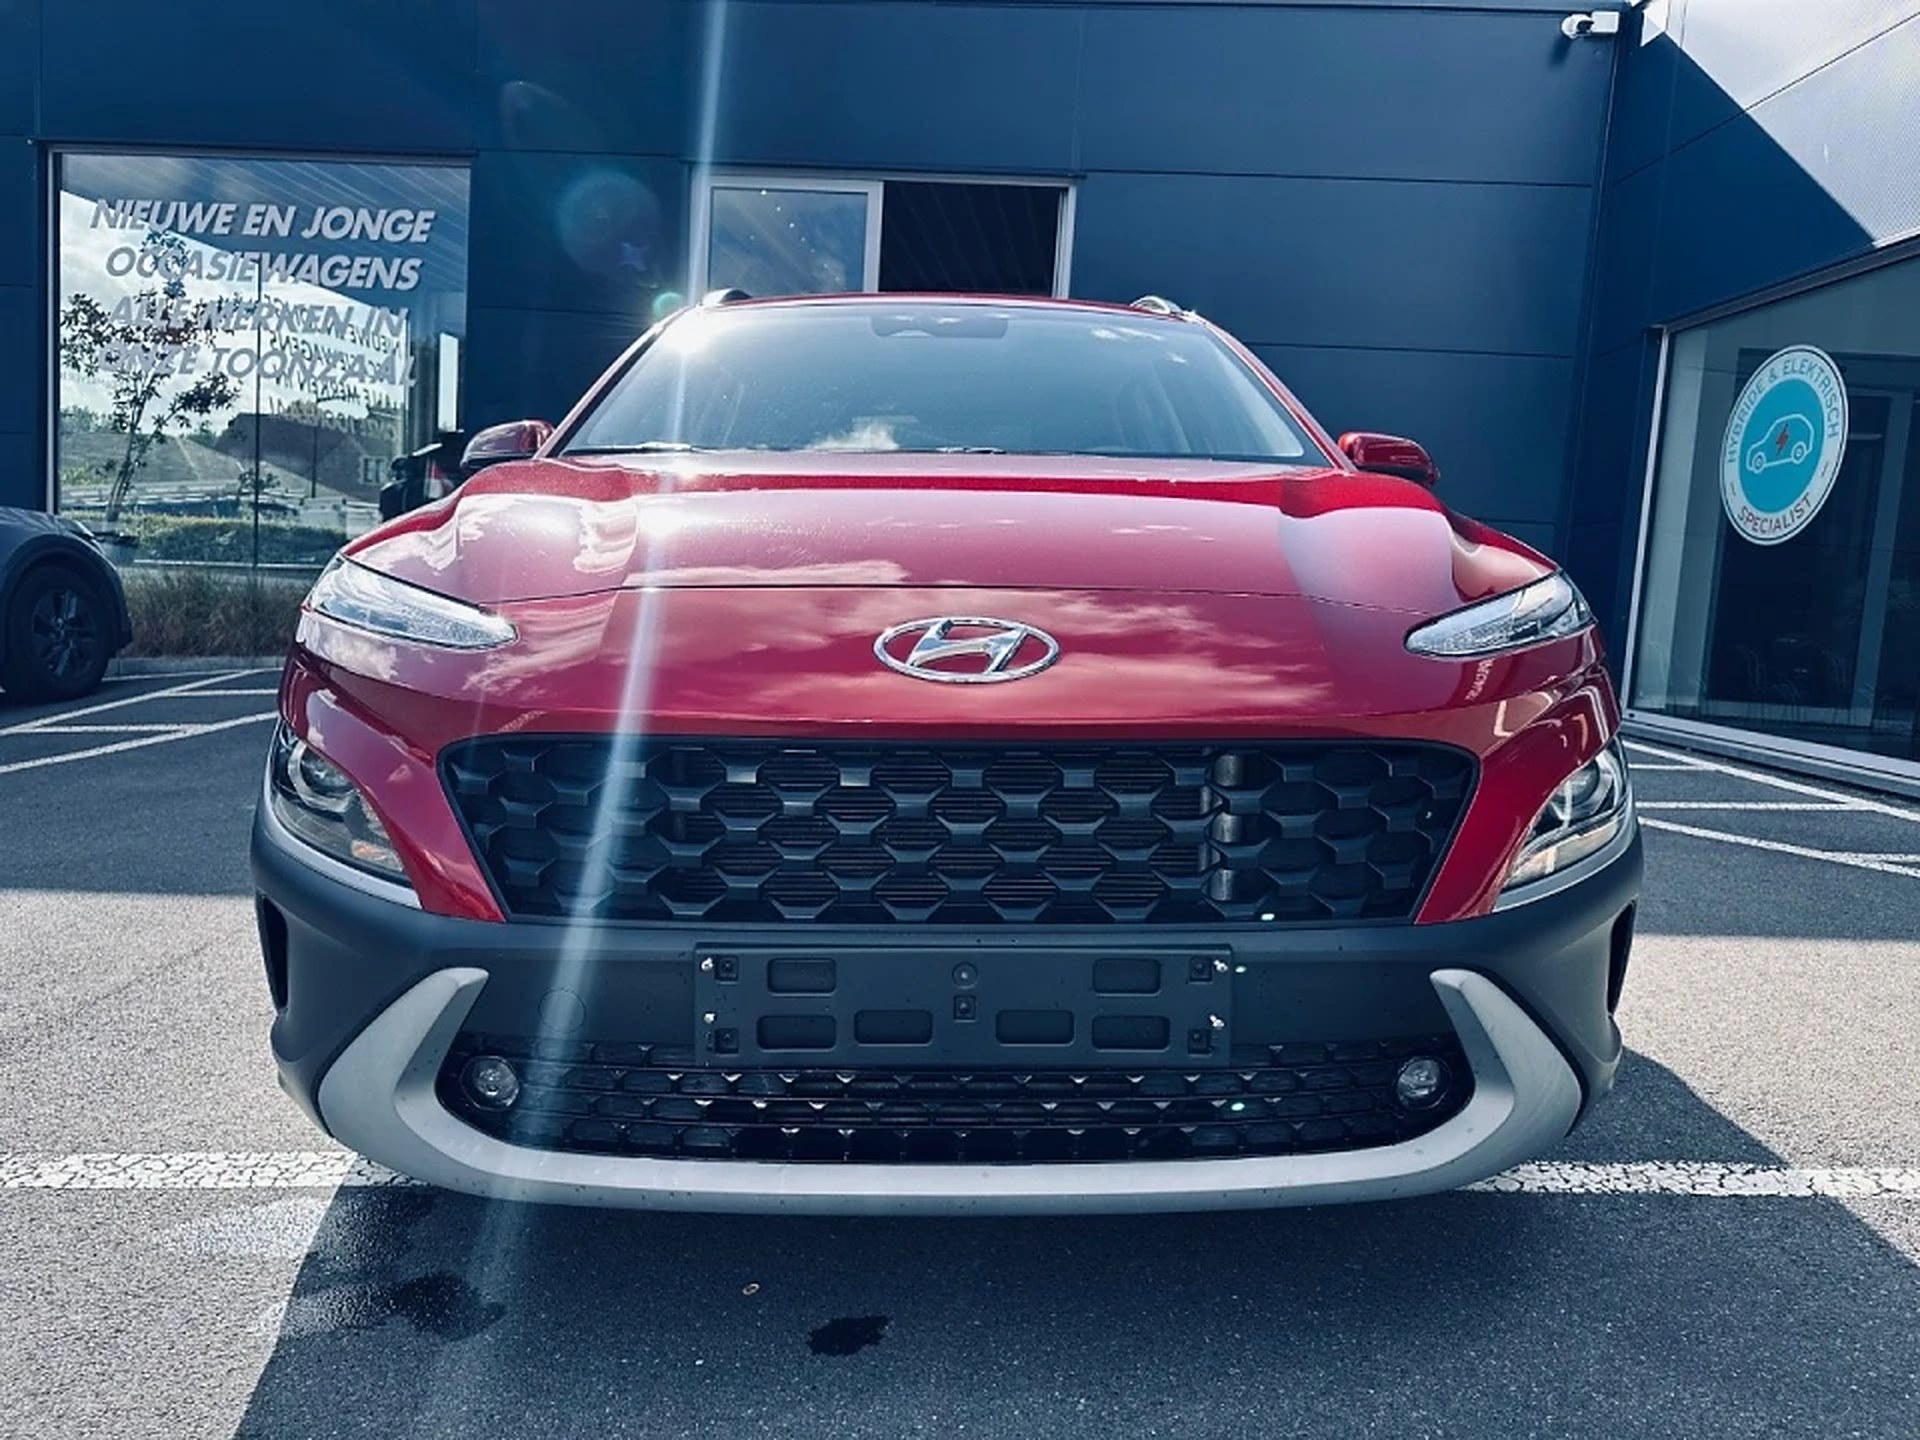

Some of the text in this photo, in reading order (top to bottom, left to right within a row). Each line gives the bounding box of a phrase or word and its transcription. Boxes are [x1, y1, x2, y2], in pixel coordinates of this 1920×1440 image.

[90, 199, 436, 243] NIEUWE EN JONGE
[106, 246, 422, 290] OCCASIEWAGENS
[362, 305, 409, 338] IN
[1783, 358, 1840, 438] ELEKTRISCH
[1737, 491, 1813, 534] SPECIALIST
